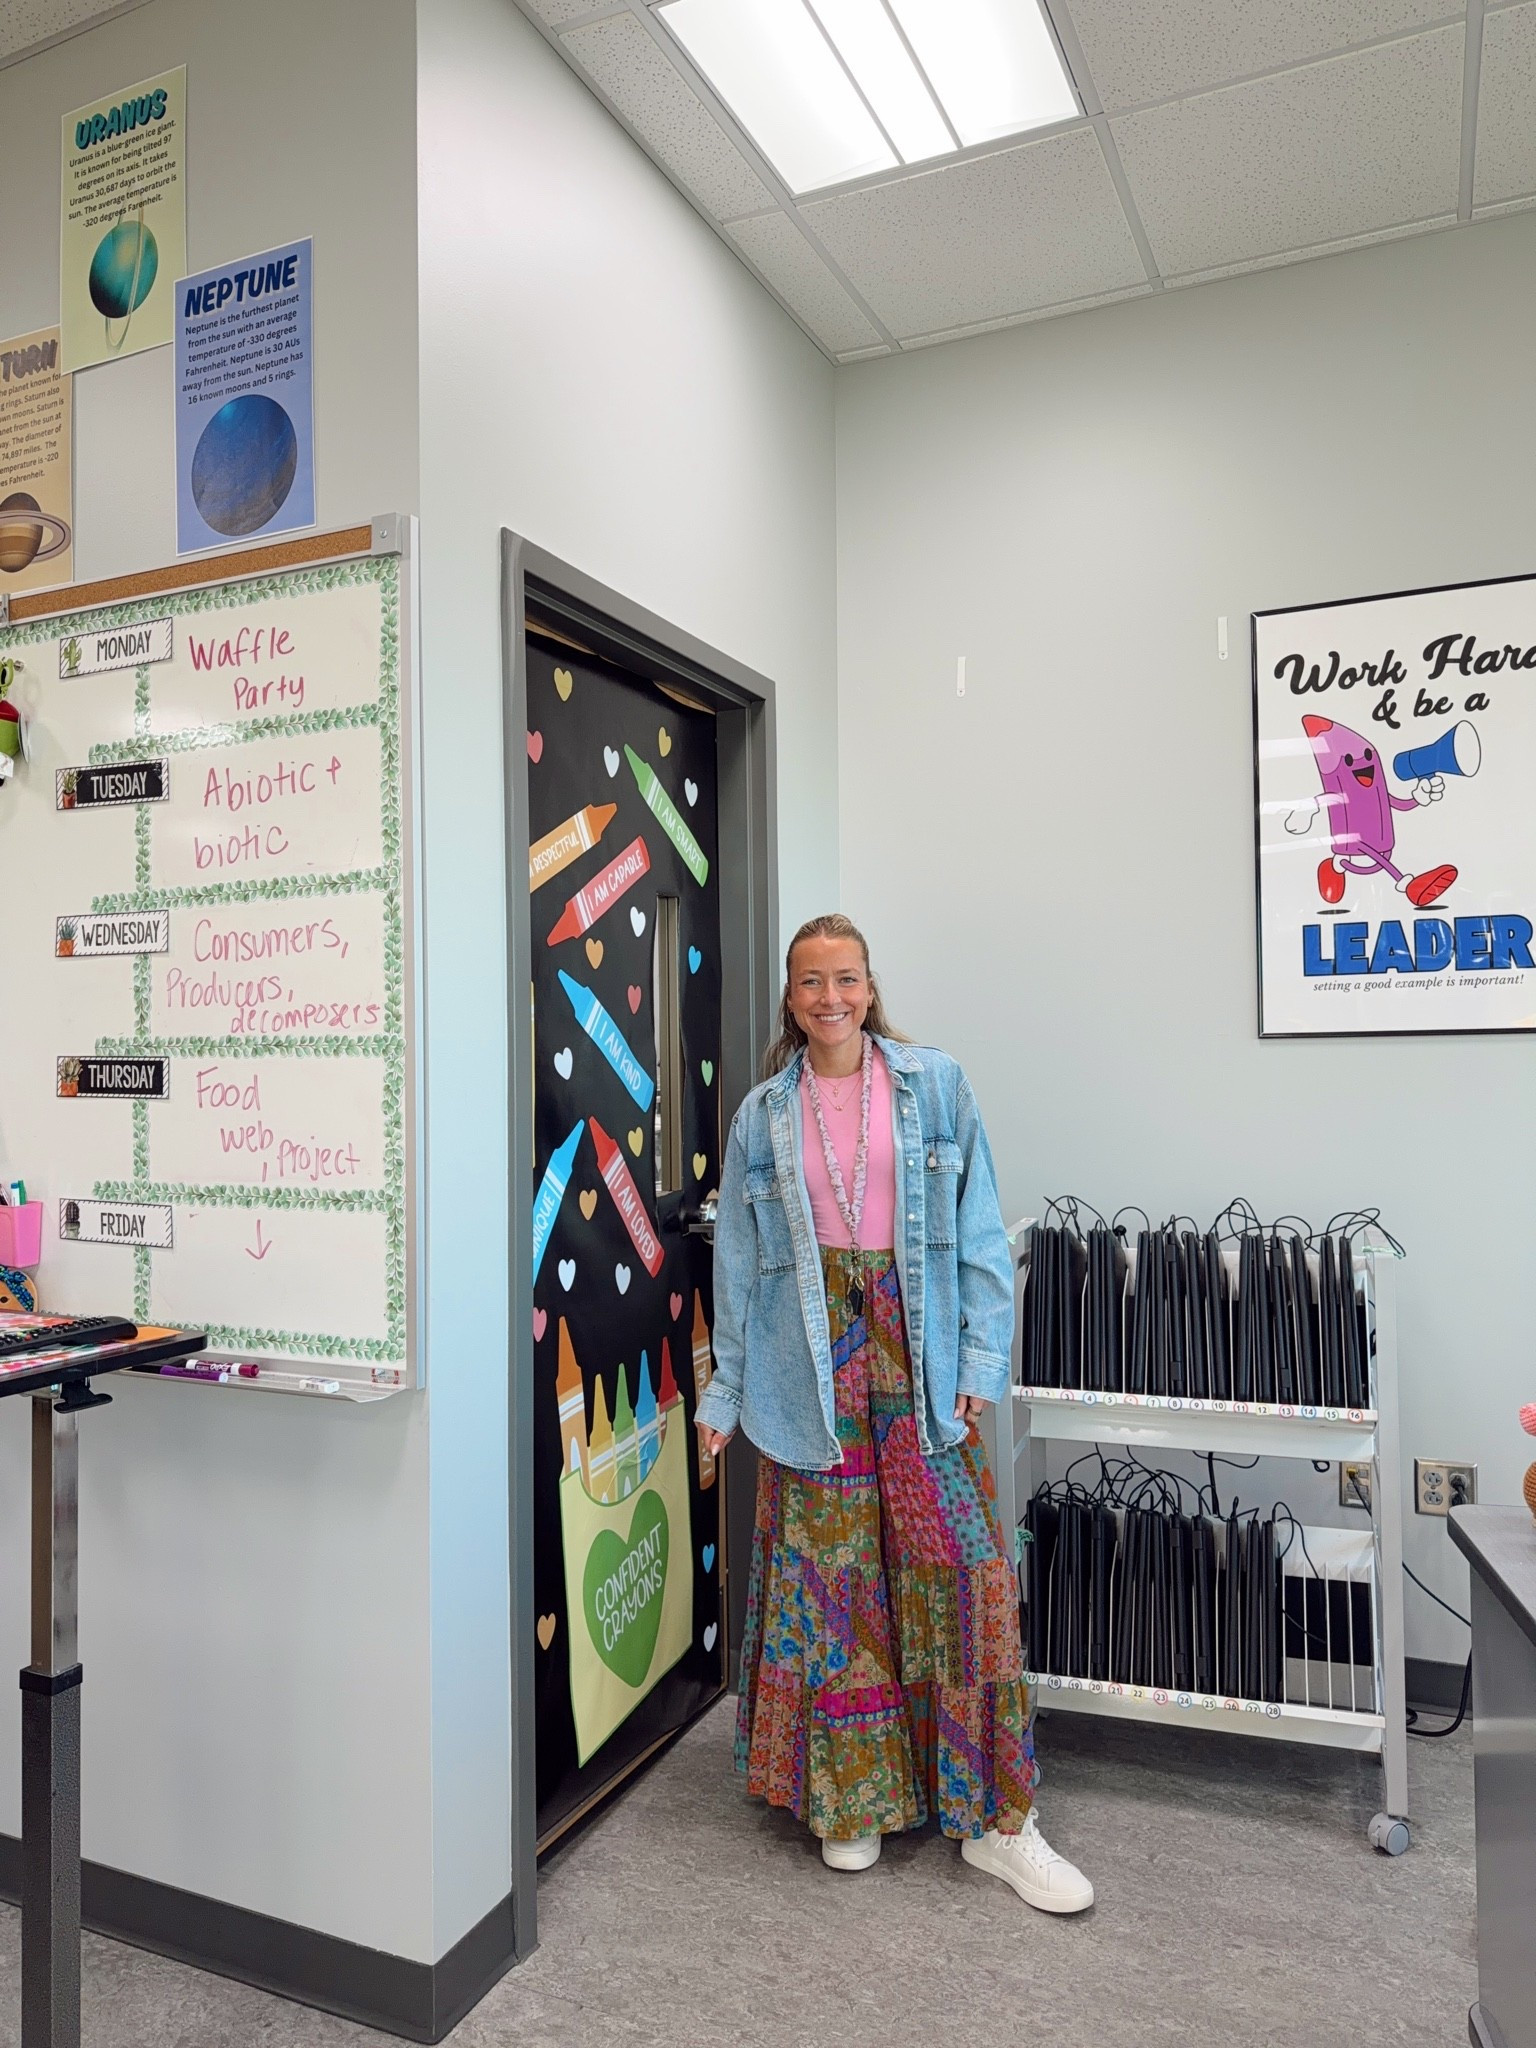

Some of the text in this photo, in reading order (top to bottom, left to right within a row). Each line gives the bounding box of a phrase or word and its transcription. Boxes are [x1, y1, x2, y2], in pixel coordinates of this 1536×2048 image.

[75, 88, 168, 150] URANUS
[70, 153, 94, 168] Uranus
[95, 150, 100, 158] is
[107, 134, 144, 153] blue-green
[146, 128, 156, 137] ice
[157, 120, 176, 134] giant.
[74, 134, 172, 179] It is known for being tilted 97
[70, 161, 176, 206] Uranus 30,687 days to orbit the
[78, 150, 168, 190] degrees on its axis. It takes
[68, 174, 177, 220] sun. The average temperature is
[83, 194, 163, 228] -320 degrees Farenheit.
[184, 254, 298, 318] NEPTUNE
[186, 294, 300, 335] Neptune is the furthest planet
[188, 310, 297, 349] from the sun with an average
[185, 338, 300, 377] Fahrenheit. Neptune is 30 AUs
[188, 324, 297, 362] temperature of -330 degrees
[8, 383, 28, 396] planet
[30, 377, 51, 388] known
[182, 351, 303, 392] away from the sun. Neptune has
[188, 368, 296, 404] 16 known moons and 5 rings.
[24, 392, 45, 403] Saturn
[47, 387, 59, 396] also
[37, 401, 58, 412] Saturn
[12, 424, 62, 445] The diameter of
[14, 422, 29, 431] from
[30, 419, 41, 427] the
[43, 415, 54, 424] sun
[55, 412, 61, 420] at
[2, 449, 22, 460] 74,897
[45, 440, 56, 449] The
[45, 452, 59, 462] -220
[9, 470, 45, 485] Fahrenheit.
[97, 630, 152, 662] MONDAY
[189, 627, 295, 671] Waffle
[1274, 649, 1407, 695] Work
[233, 675, 305, 711] Party
[1372, 688, 1490, 729] & be a
[90, 771, 148, 799] TUESDAY
[204, 761, 316, 812] Abiotic
[194, 825, 289, 869] biotic
[533, 831, 580, 874] RESPECTFUL
[662, 809, 702, 870] AM SMART
[587, 850, 643, 912] I AM CAPABLE
[82, 920, 160, 948] WEDNESDAY
[194, 918, 349, 963] Consumers,
[1302, 914, 1536, 976] LEADER
[1313, 980, 1351, 992] setting
[1364, 978, 1391, 992] good
[1395, 977, 1443, 991] example
[1447, 977, 1456, 987] is
[1459, 974, 1524, 989] important!
[230, 1003, 380, 1034] decomposers
[600, 1021, 642, 1092] I AM KIND
[88, 1064, 156, 1090] THURSDAY
[196, 1066, 260, 1110] Food
[220, 1121, 274, 1153] web
[100, 1212, 146, 1238] FRIDAY
[614, 1174, 654, 1260] I AM LOVED
[1304, 1408, 1313, 1416] 14
[596, 1522, 662, 1622] CONFIDENT
[603, 1559, 663, 1652] CRAYONS
[1027, 1674, 1036, 1682] 17
[1091, 1683, 1100, 1691] 20
[1180, 1697, 1189, 1705] 24
[1205, 1700, 1214, 1708] 25
[1268, 1707, 1278, 1715] 28
